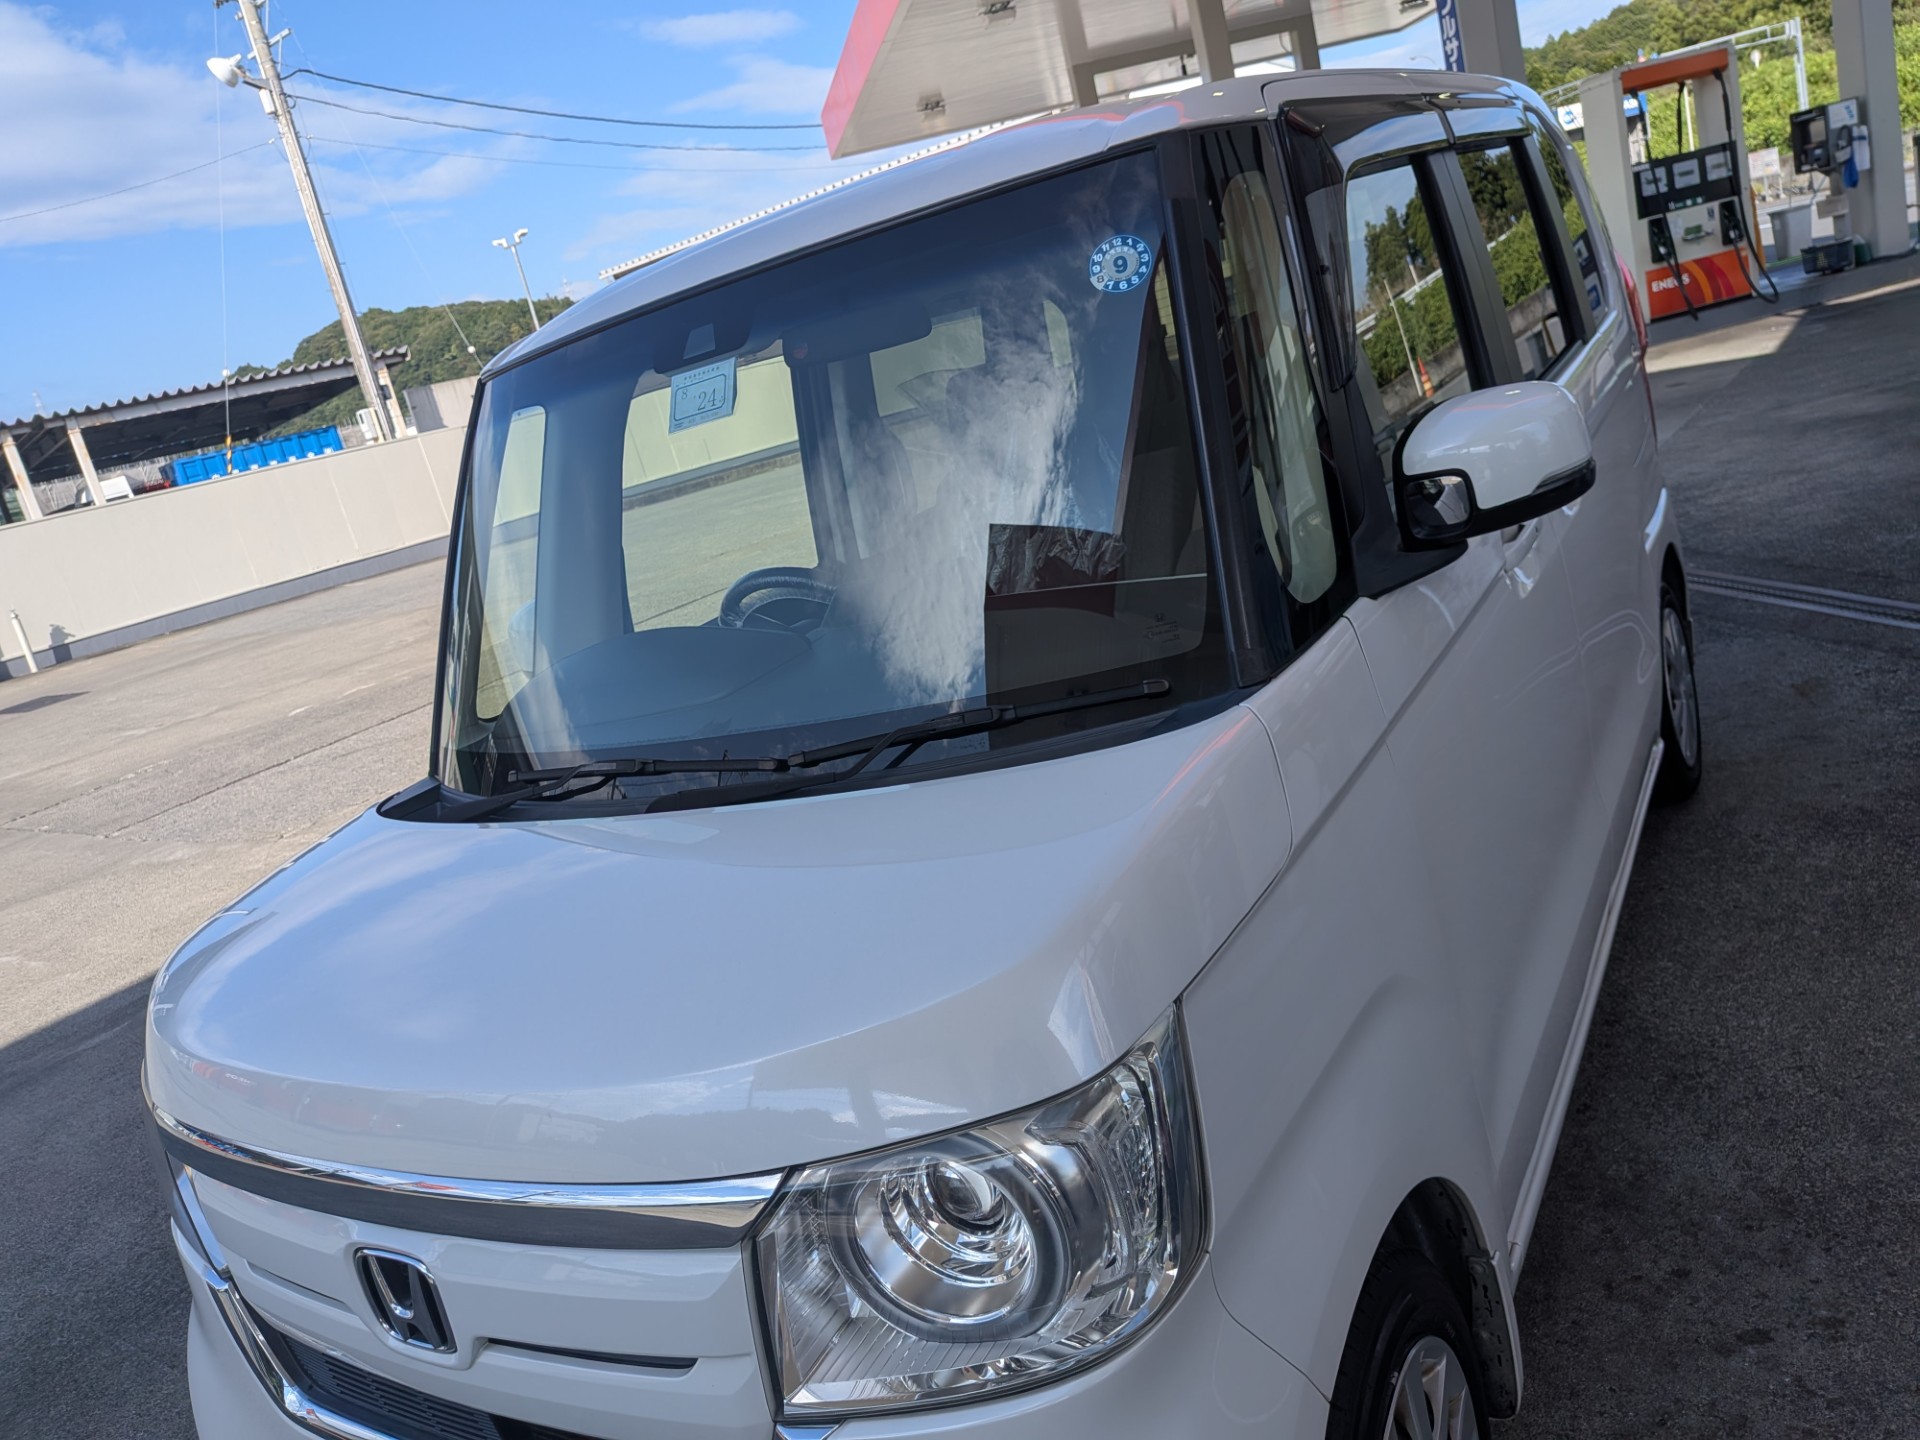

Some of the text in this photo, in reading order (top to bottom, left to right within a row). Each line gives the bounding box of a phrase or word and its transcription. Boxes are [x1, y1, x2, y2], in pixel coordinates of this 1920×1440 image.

[1112, 238, 1122, 246] 12
[1126, 238, 1133, 246] 1
[1102, 243, 1110, 252] 11
[1136, 243, 1145, 252] 2
[1092, 253, 1103, 262] 10
[1140, 253, 1149, 262] 3
[1092, 265, 1101, 273] 9
[1112, 255, 1128, 274] 9
[1139, 265, 1147, 273] 4
[1096, 275, 1105, 283] 8
[1131, 275, 1139, 284] 5
[1106, 281, 1115, 290] 7
[1119, 281, 1128, 290] 6
[681, 388, 689, 400] 8
[697, 387, 717, 411] 24
